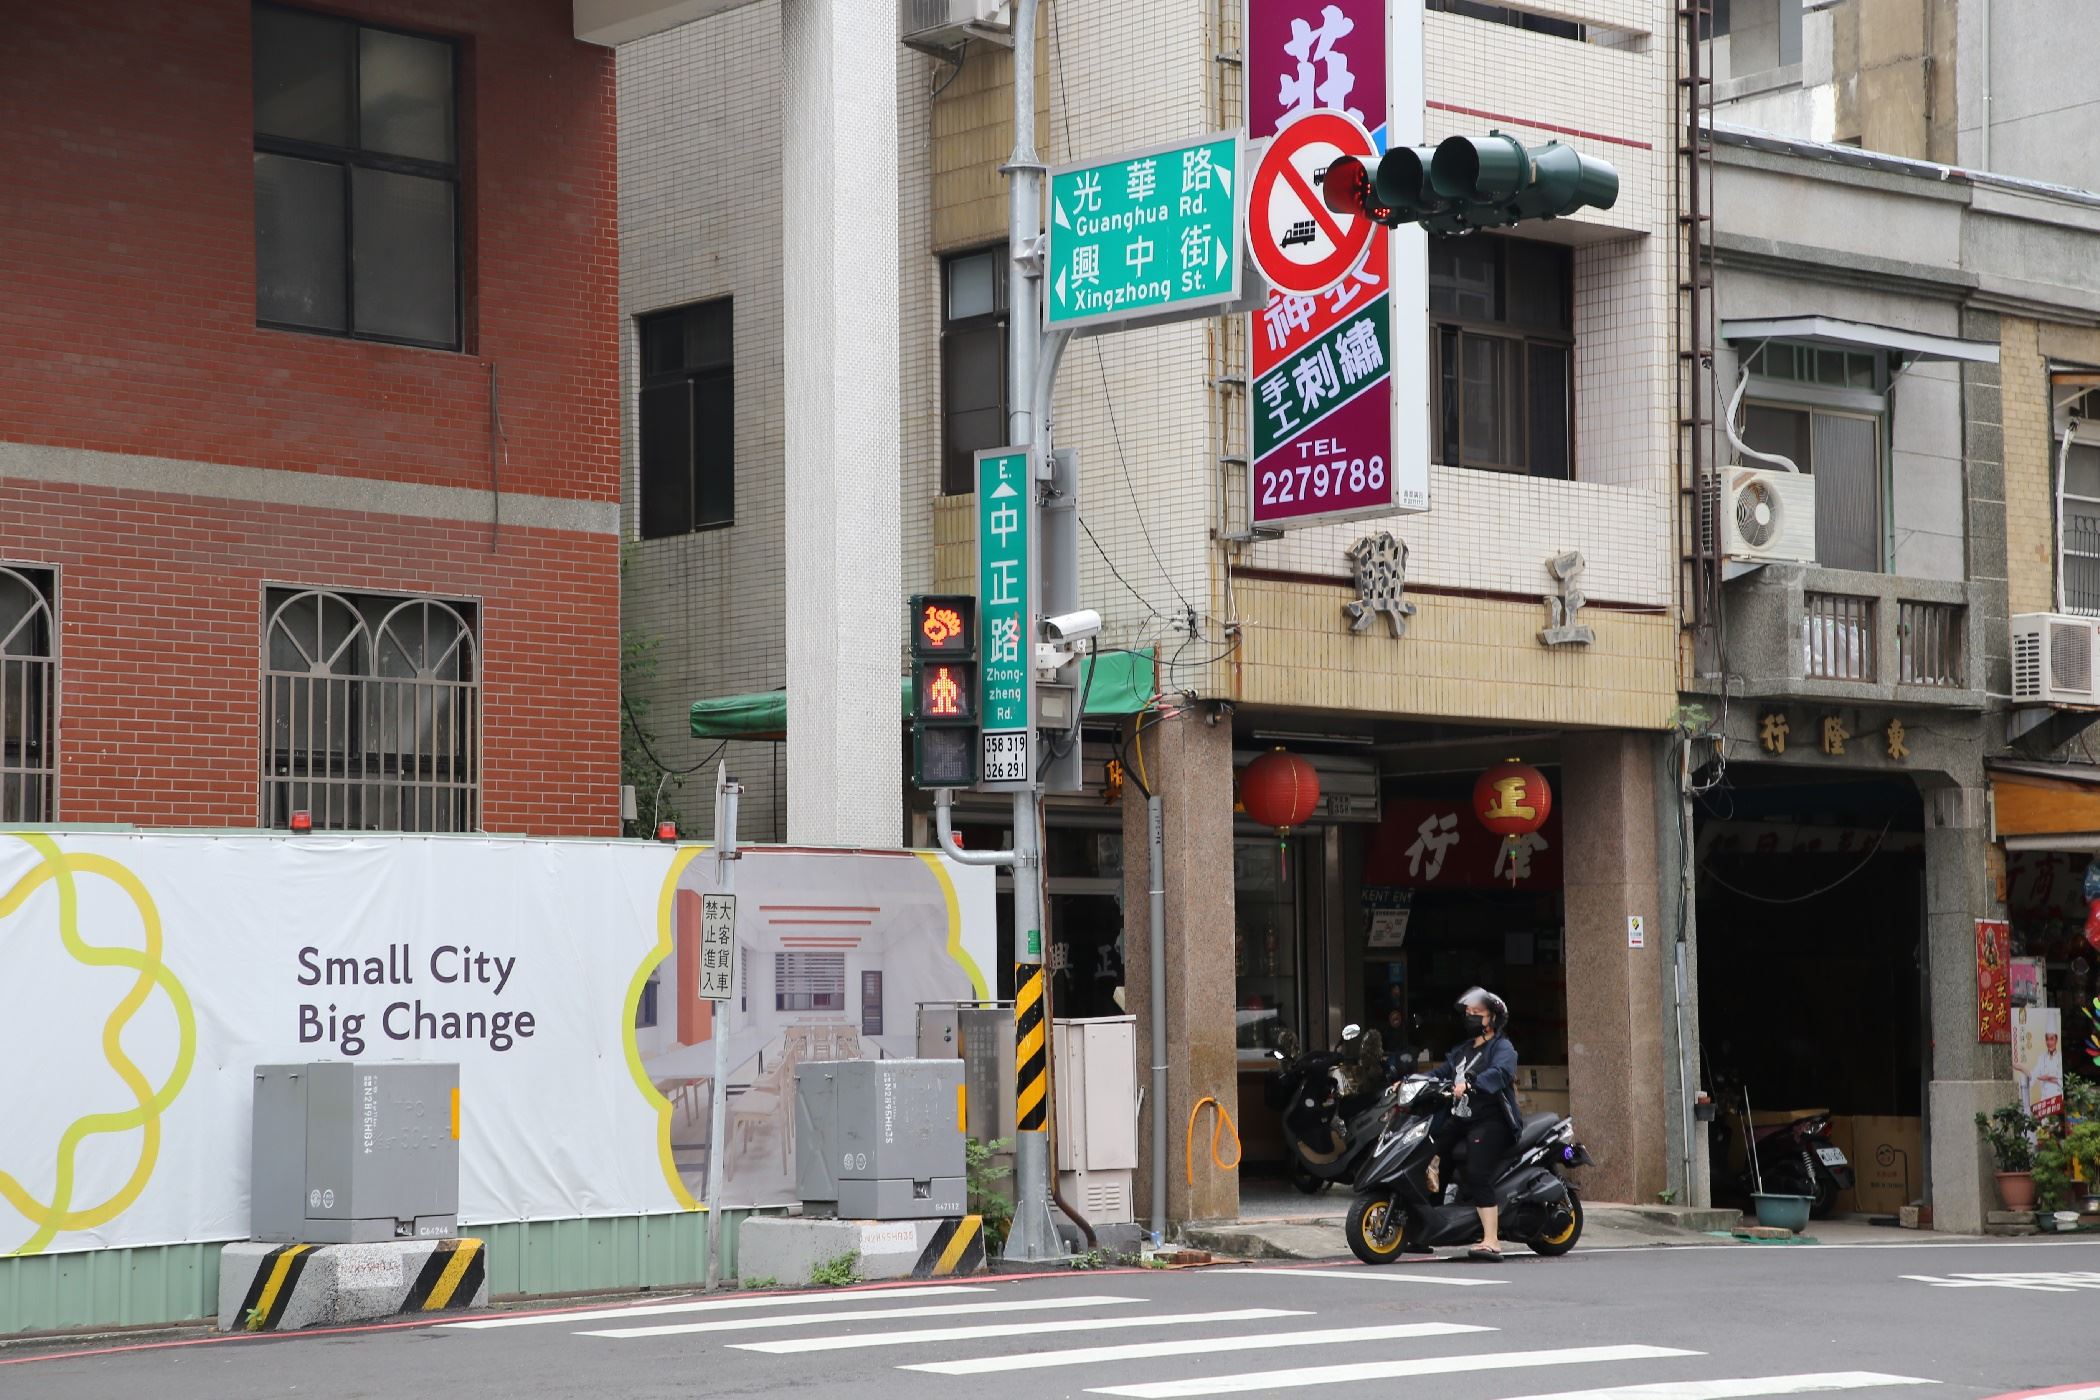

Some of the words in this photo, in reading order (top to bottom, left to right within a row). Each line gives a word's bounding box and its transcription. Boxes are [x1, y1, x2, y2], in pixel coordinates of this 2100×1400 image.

[1073, 148, 1213, 215] 光華路
[1076, 205, 1169, 237] Guanghua
[1179, 193, 1207, 217] Rd.
[1072, 224, 1212, 289] 興中街
[1074, 279, 1171, 312] Xingzhong
[1181, 270, 1206, 292] St.
[999, 459, 1012, 479] E.
[1296, 437, 1347, 459] TEL
[1262, 455, 1385, 505] 2279788
[990, 502, 1020, 662] 中正路
[986, 668, 1024, 683] Zhong-
[989, 687, 1022, 702] zheng
[997, 707, 1013, 720] Rd.
[986, 737, 1004, 753] 358
[1007, 736, 1025, 753] 319
[986, 763, 1004, 778] 326
[1007, 762, 1024, 777] 291
[1484, 776, 1536, 820] 正
[703, 900, 718, 991] 禁止進入
[716, 901, 732, 992] 大客貨車
[297, 943, 413, 986] Small
[430, 945, 516, 996] City
[299, 1003, 366, 1056] Big
[382, 999, 536, 1051] Change
